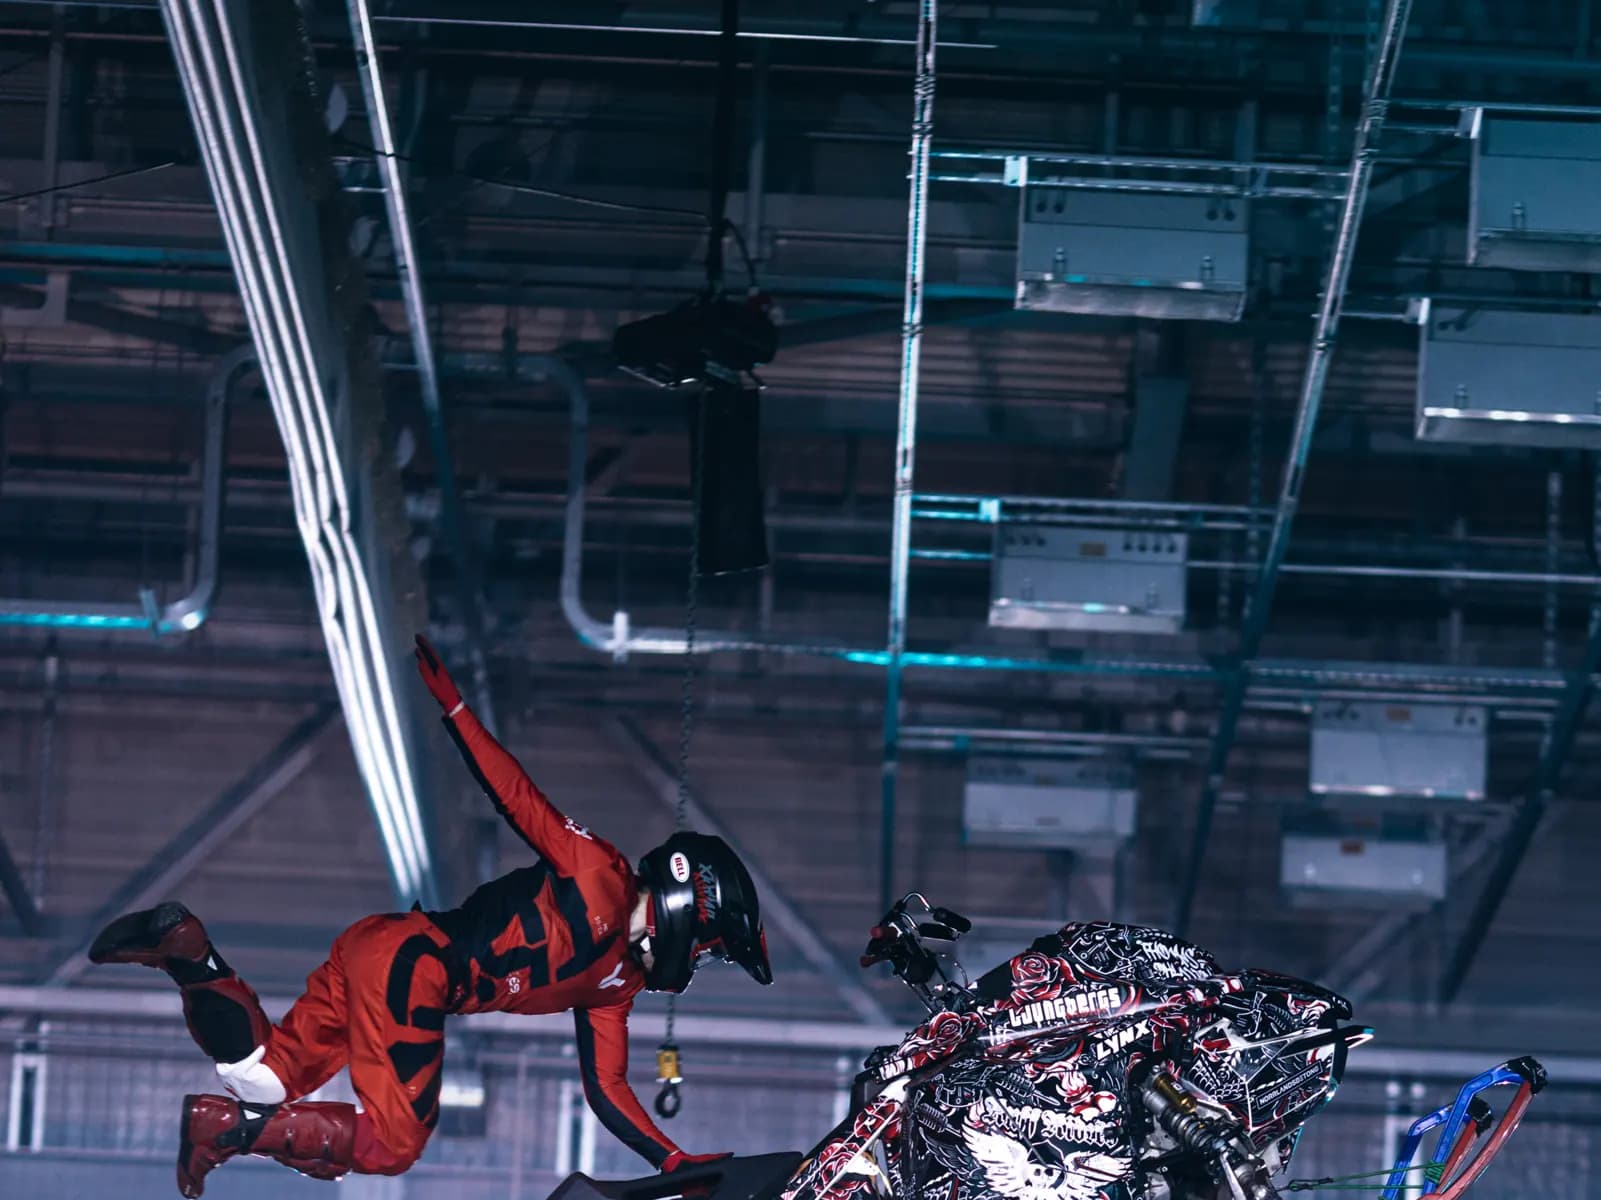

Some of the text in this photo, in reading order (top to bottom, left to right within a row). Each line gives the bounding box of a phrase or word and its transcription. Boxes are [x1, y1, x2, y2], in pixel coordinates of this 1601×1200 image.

[674, 856, 686, 877] BELL
[1097, 1019, 1151, 1061] LYNX
[1259, 1066, 1320, 1105] NORRLANDSBETONG
